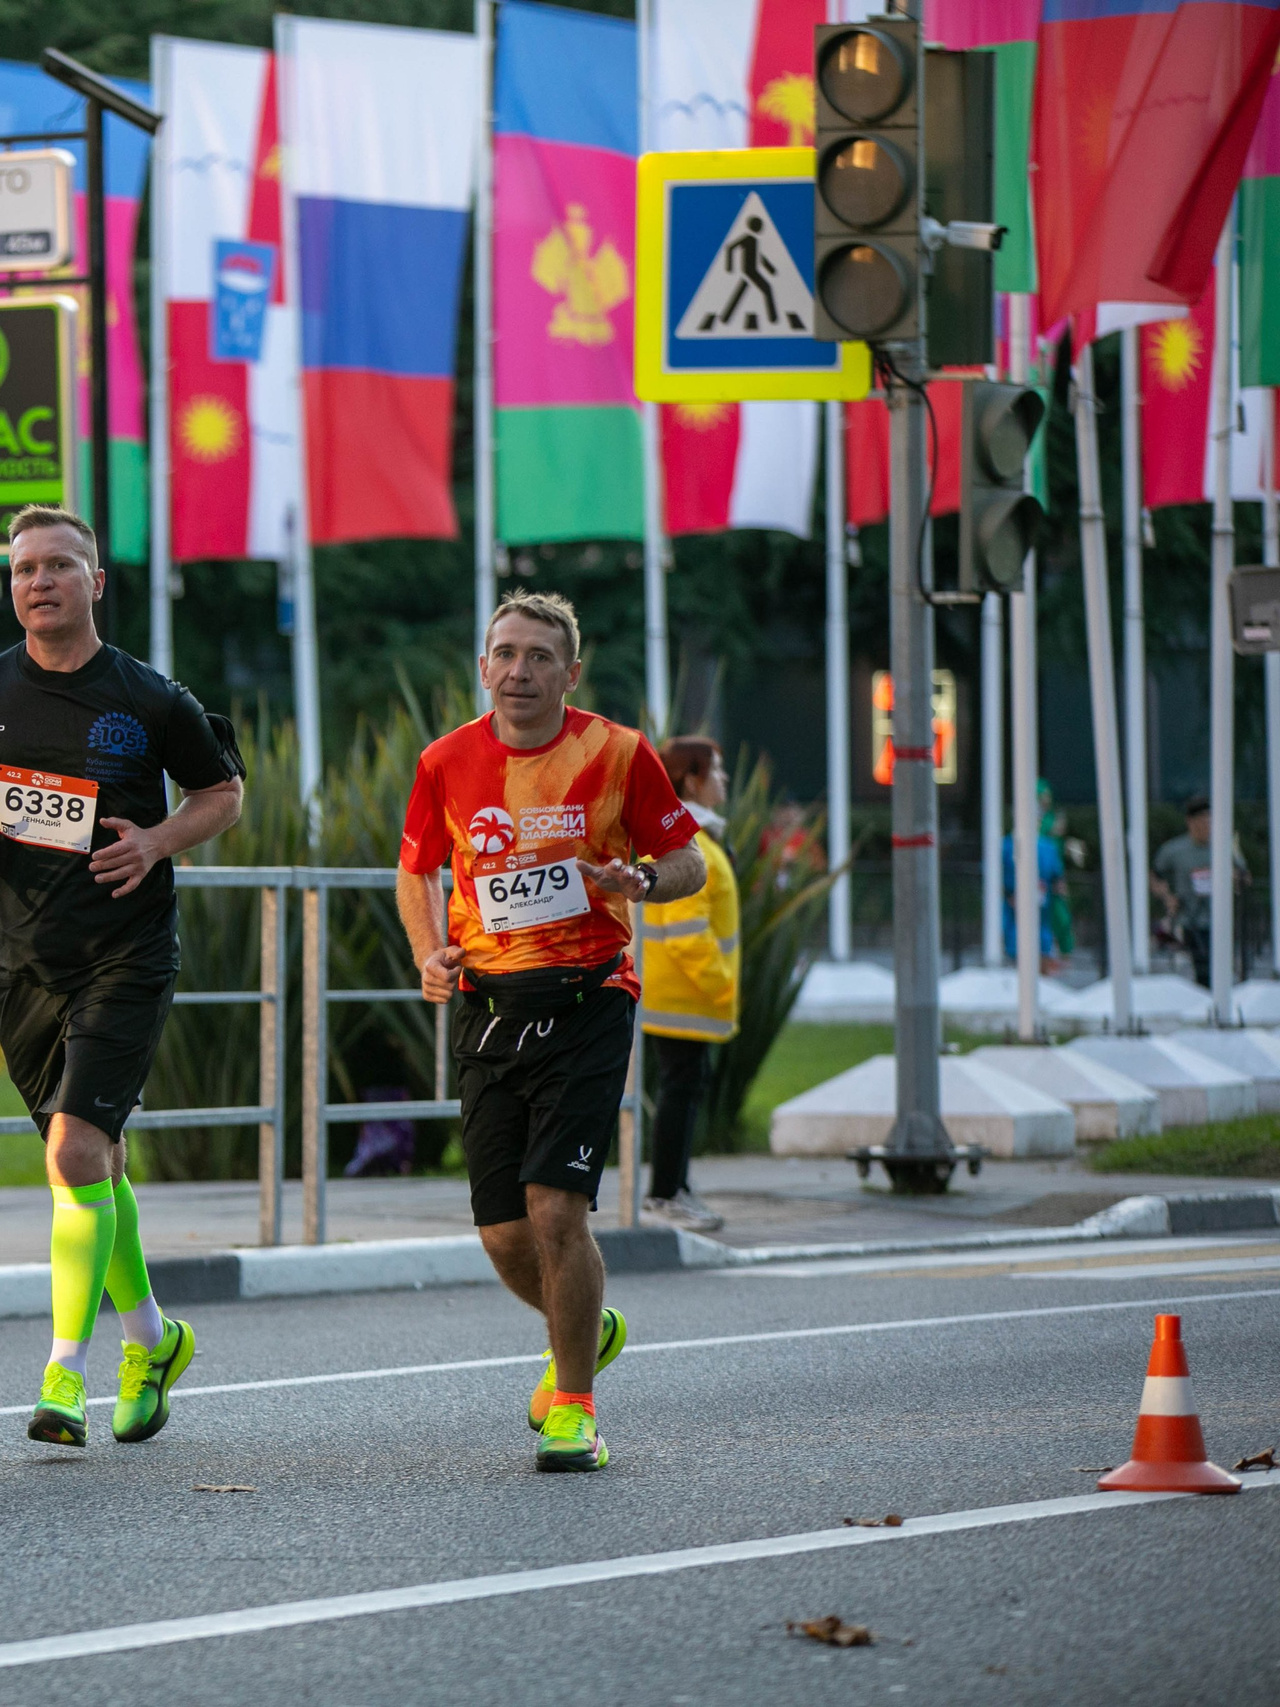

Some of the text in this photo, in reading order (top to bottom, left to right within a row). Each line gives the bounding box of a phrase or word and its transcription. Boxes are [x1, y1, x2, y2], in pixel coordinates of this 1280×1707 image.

[99, 724, 141, 750] 105
[6, 771, 22, 779] 42.2
[5, 787, 85, 823] 6338
[519, 804, 585, 815] СОВКОМБАНК
[22, 816, 62, 828] ГЕННАДИЙ
[519, 812, 586, 831] СОЧИ
[520, 828, 586, 840] МАРАФОН
[482, 862, 497, 870] 42.2
[489, 865, 570, 903] 6479
[509, 895, 555, 910] АЛЕКСАНДР
